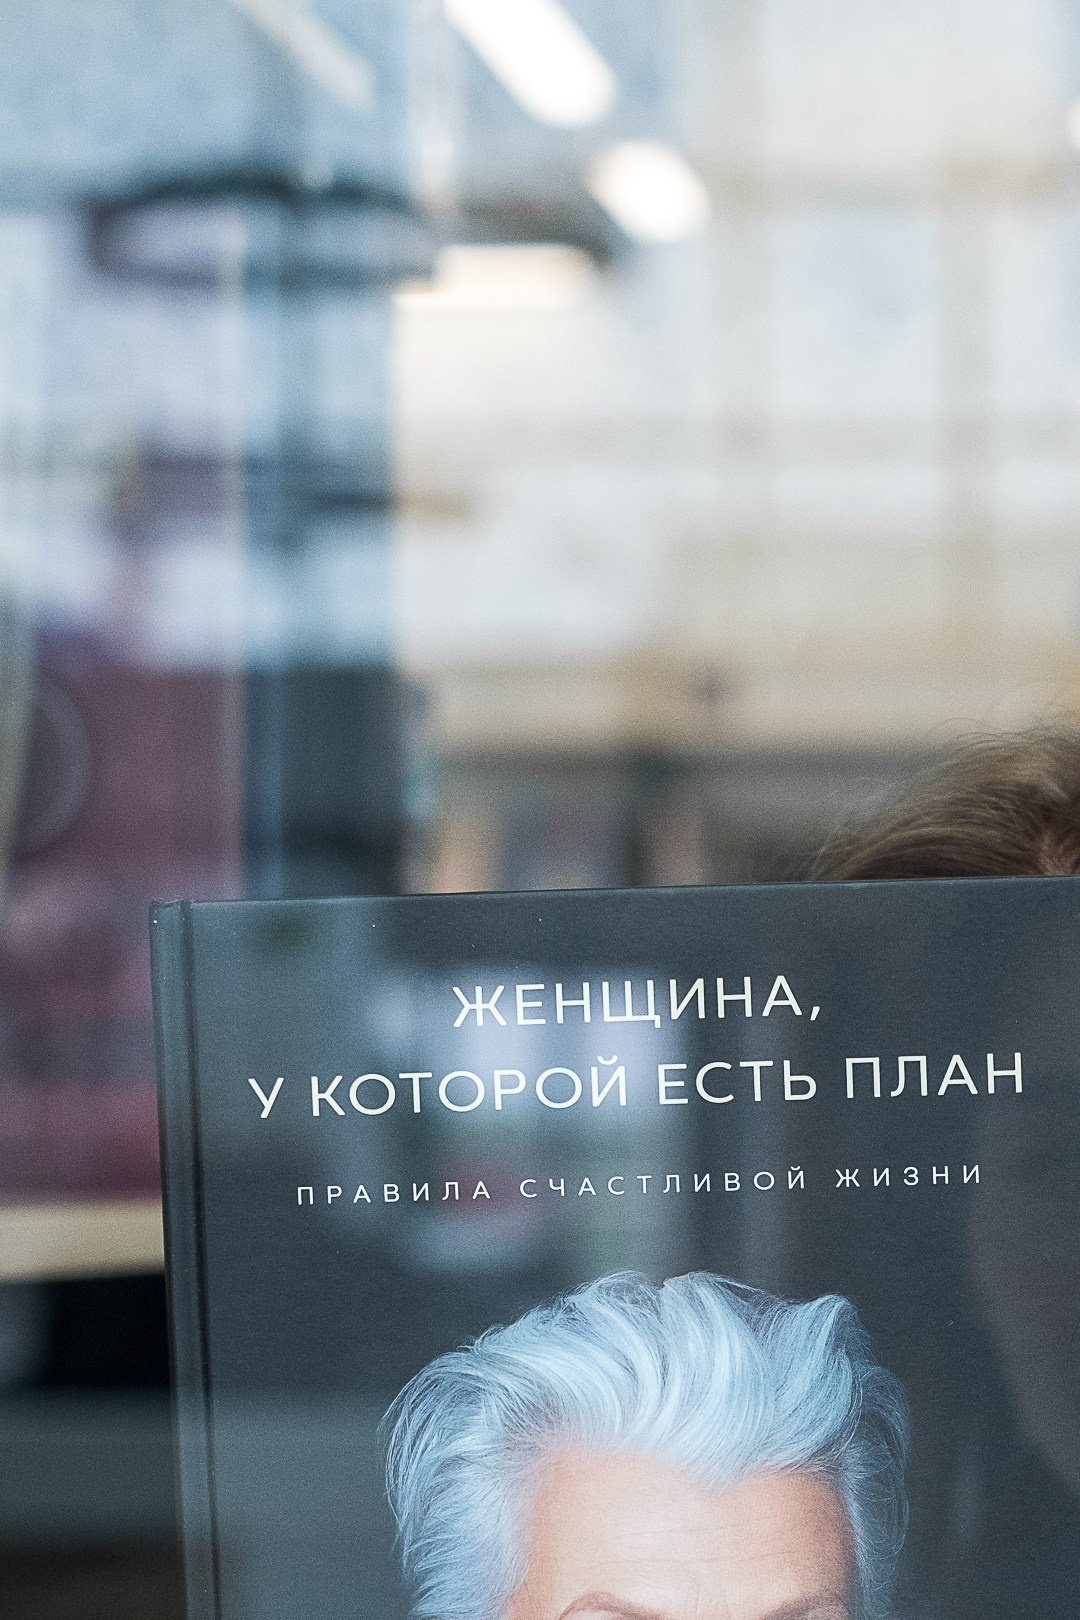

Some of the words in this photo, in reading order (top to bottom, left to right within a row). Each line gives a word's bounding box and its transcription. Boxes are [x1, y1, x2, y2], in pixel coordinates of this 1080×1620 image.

[452, 974, 822, 1029] ЖЕНЩИНА,
[247, 1076, 285, 1119] У
[310, 1055, 628, 1117] КОТОРОЙ
[656, 1059, 818, 1105] ЕСТЬ
[844, 1051, 1024, 1100] ПЛАН
[296, 1179, 492, 1206] ПРАВИЛА
[519, 1164, 806, 1199] СЧАСТЛИВОЙ
[835, 1163, 981, 1189] ЖИЗНИ
